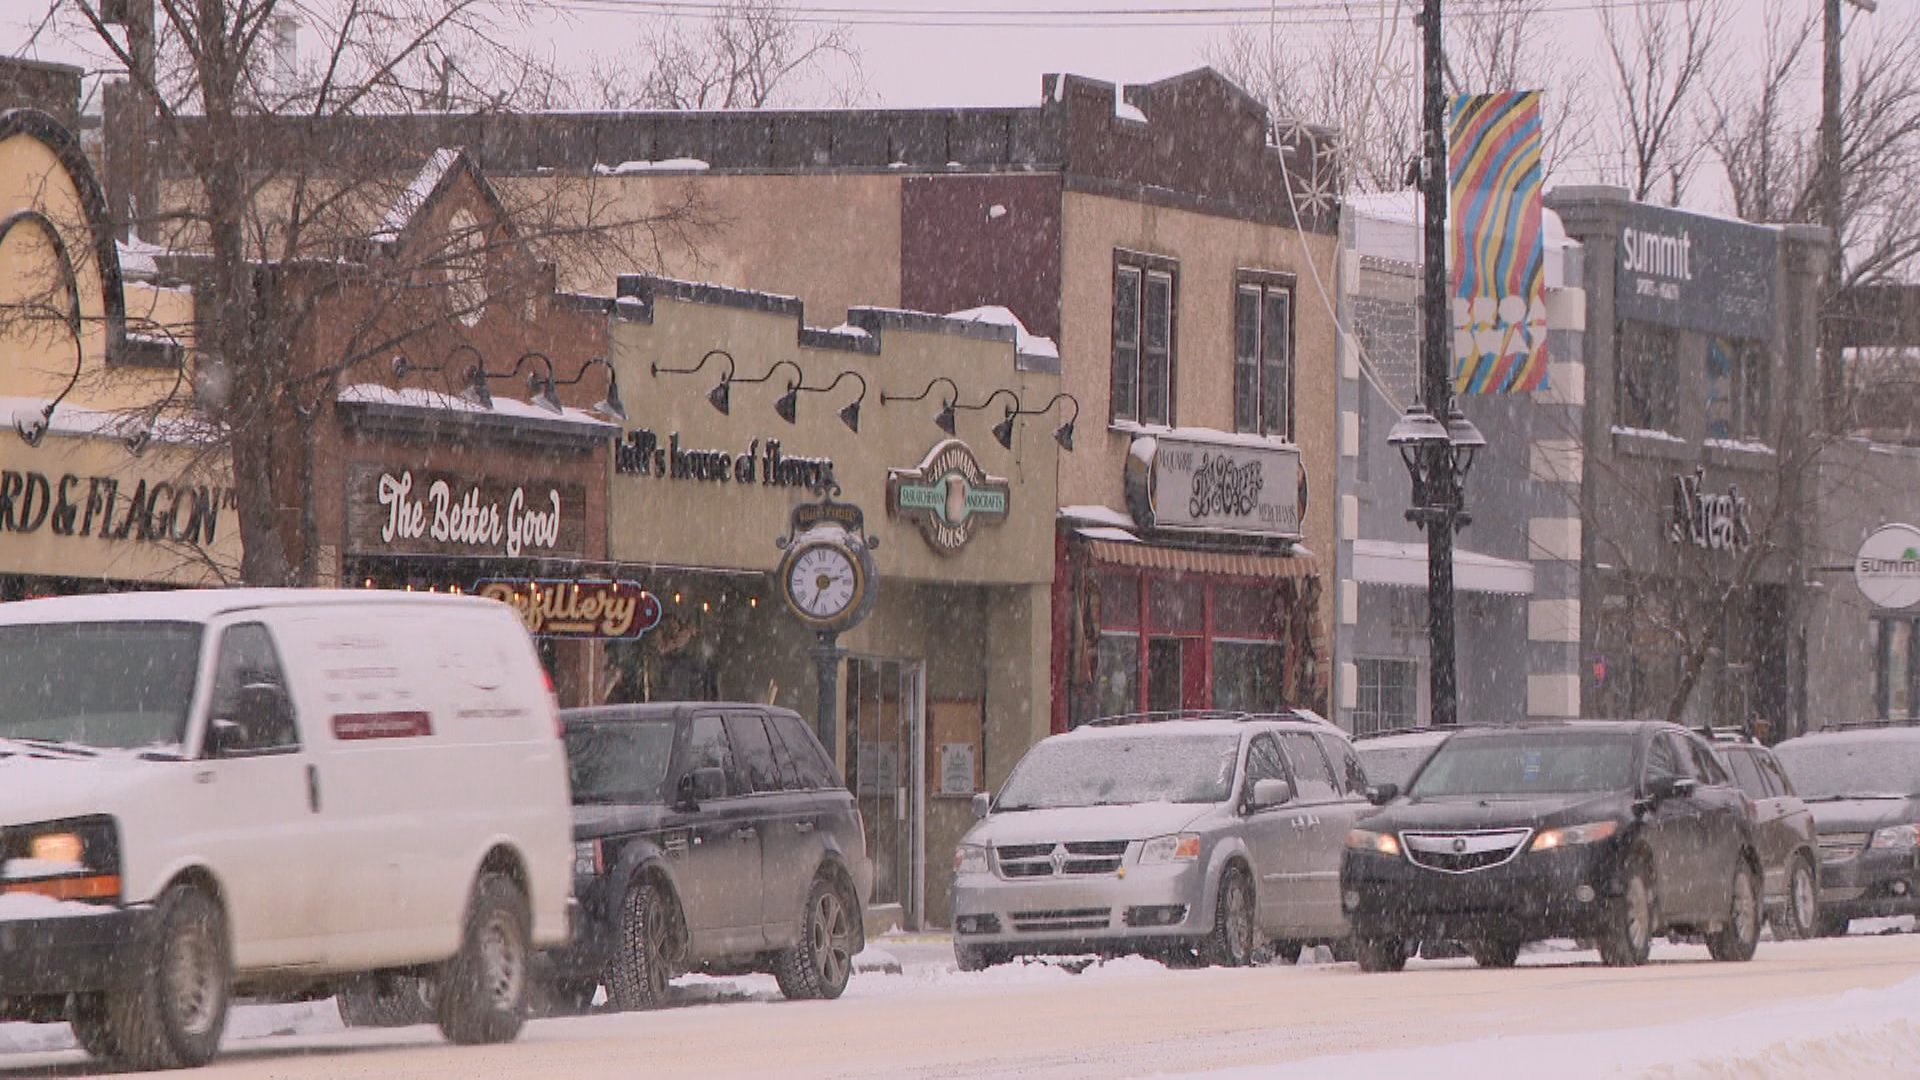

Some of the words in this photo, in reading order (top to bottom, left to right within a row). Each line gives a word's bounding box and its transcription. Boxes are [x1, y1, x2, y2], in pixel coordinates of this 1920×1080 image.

[1623, 226, 1692, 280] summit
[669, 432, 732, 482] house
[734, 436, 759, 485] of
[51, 473, 79, 536] &
[79, 476, 220, 546] FLAGON
[379, 471, 426, 542] The
[429, 479, 503, 545] Better
[507, 486, 560, 558] Good
[937, 522, 968, 547] HOUSE
[1862, 560, 1920, 573] summ
